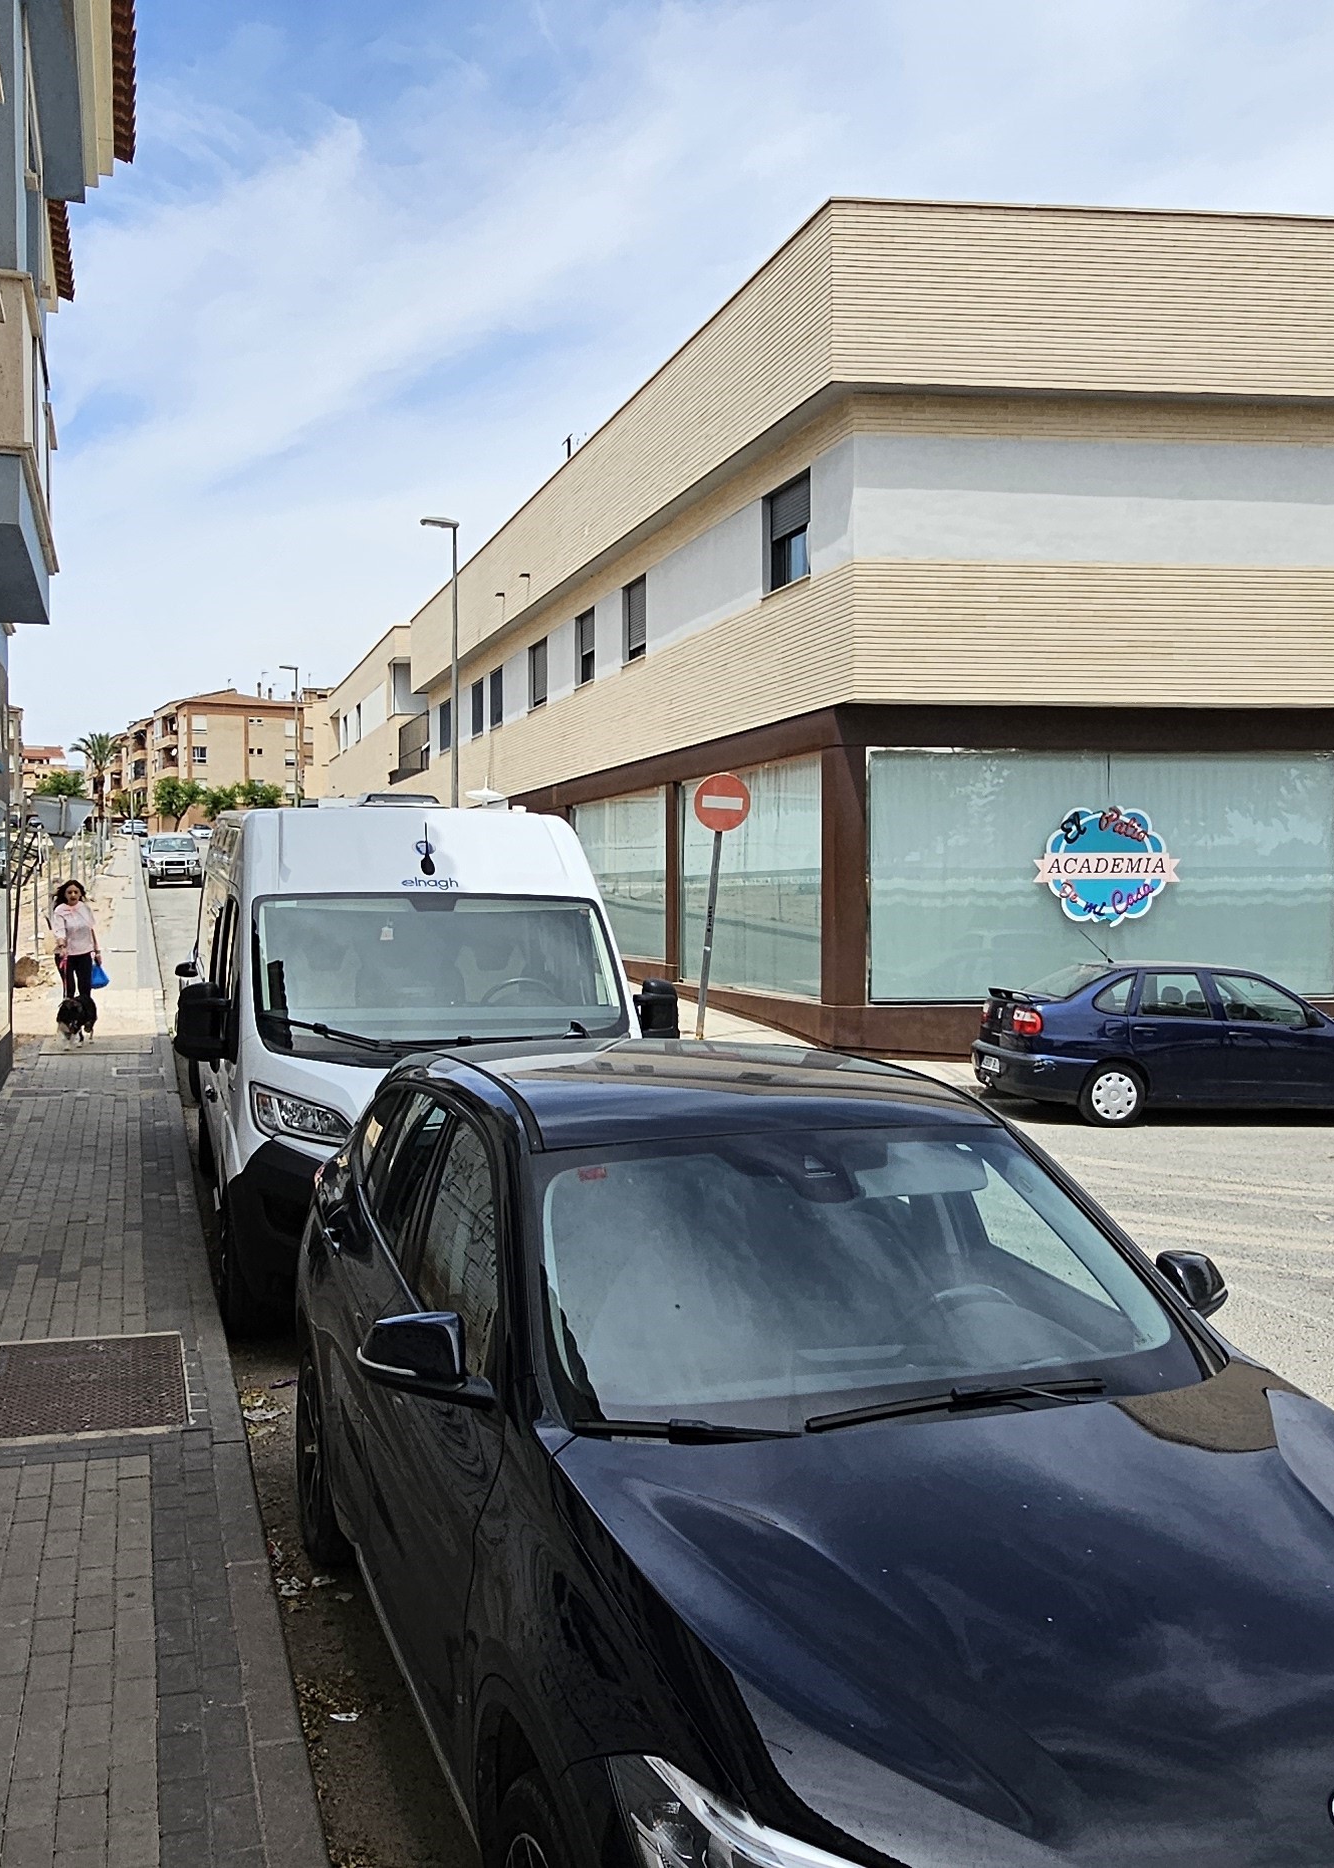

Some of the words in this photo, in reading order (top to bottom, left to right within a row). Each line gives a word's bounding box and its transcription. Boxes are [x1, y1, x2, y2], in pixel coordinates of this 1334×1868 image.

[1060, 811, 1087, 844] El
[1097, 805, 1150, 842] Patio
[1047, 857, 1167, 875] ACADEMIA
[401, 876, 459, 891] elnagh
